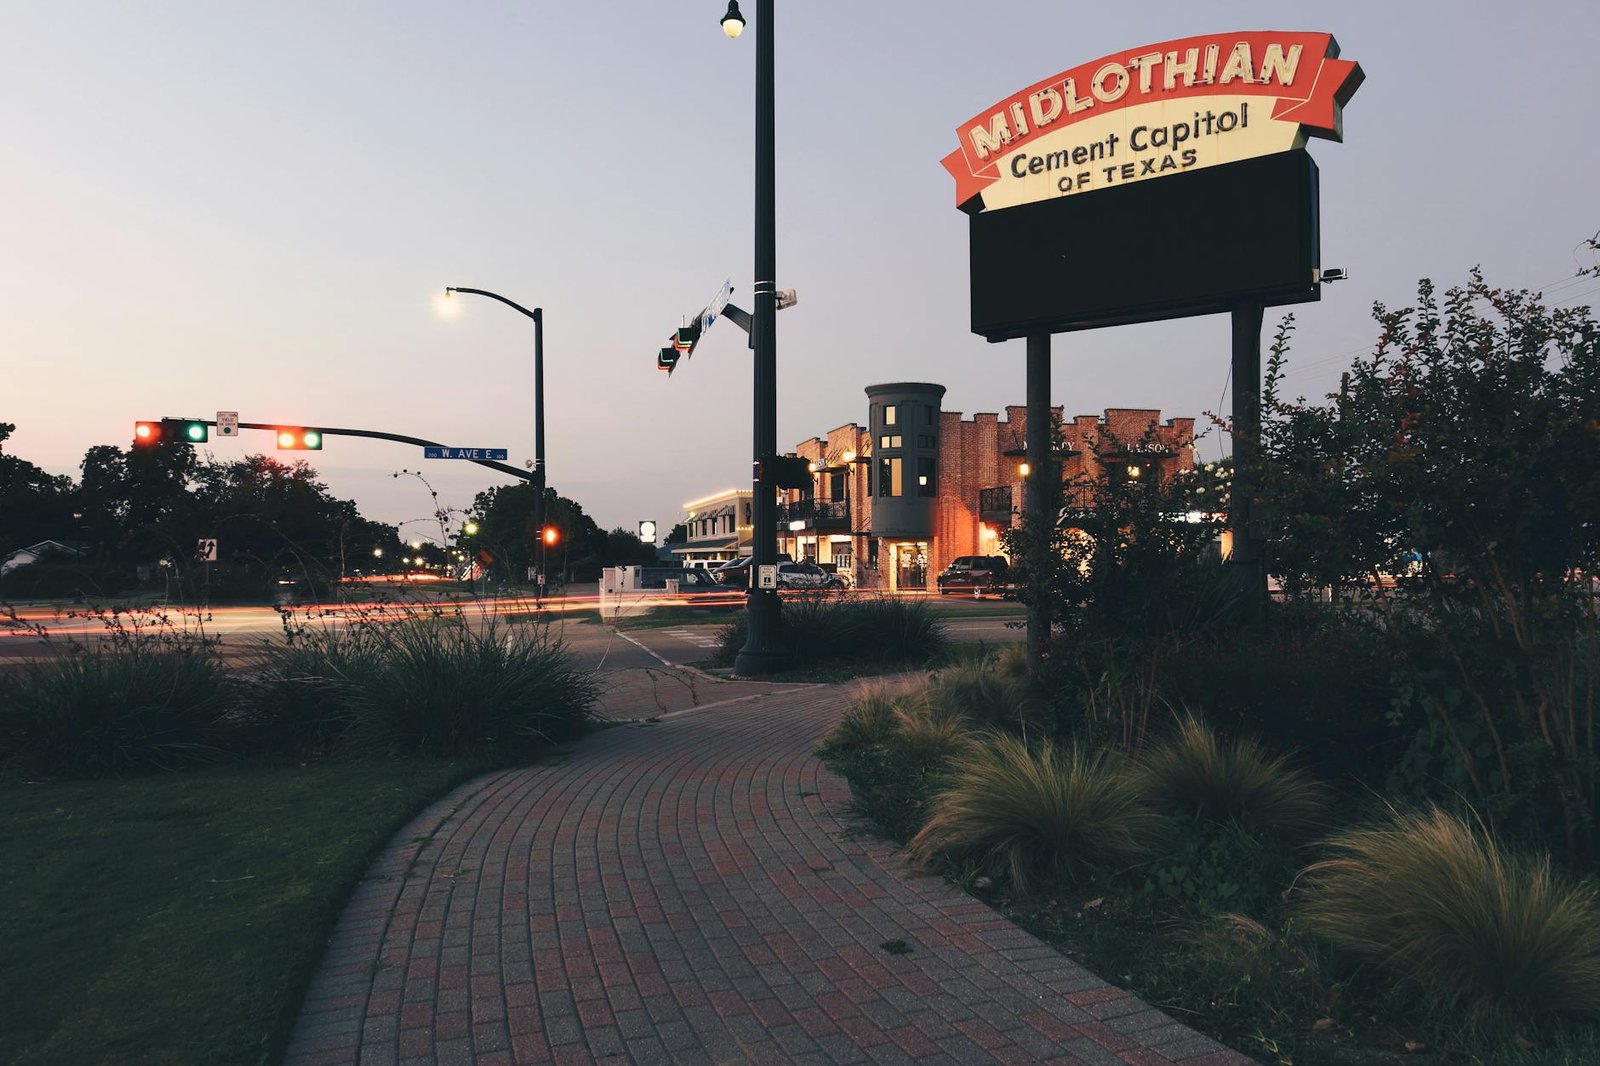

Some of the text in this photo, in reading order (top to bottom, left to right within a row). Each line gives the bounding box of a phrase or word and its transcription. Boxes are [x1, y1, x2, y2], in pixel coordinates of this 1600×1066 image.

[968, 41, 1303, 160] MIDLOTHIAN
[1010, 102, 1248, 179] Cement Capitol
[1057, 148, 1198, 193] OF TEXAS
[441, 449, 453, 458] W.
[457, 449, 479, 459] AVE
[485, 449, 492, 459] E
